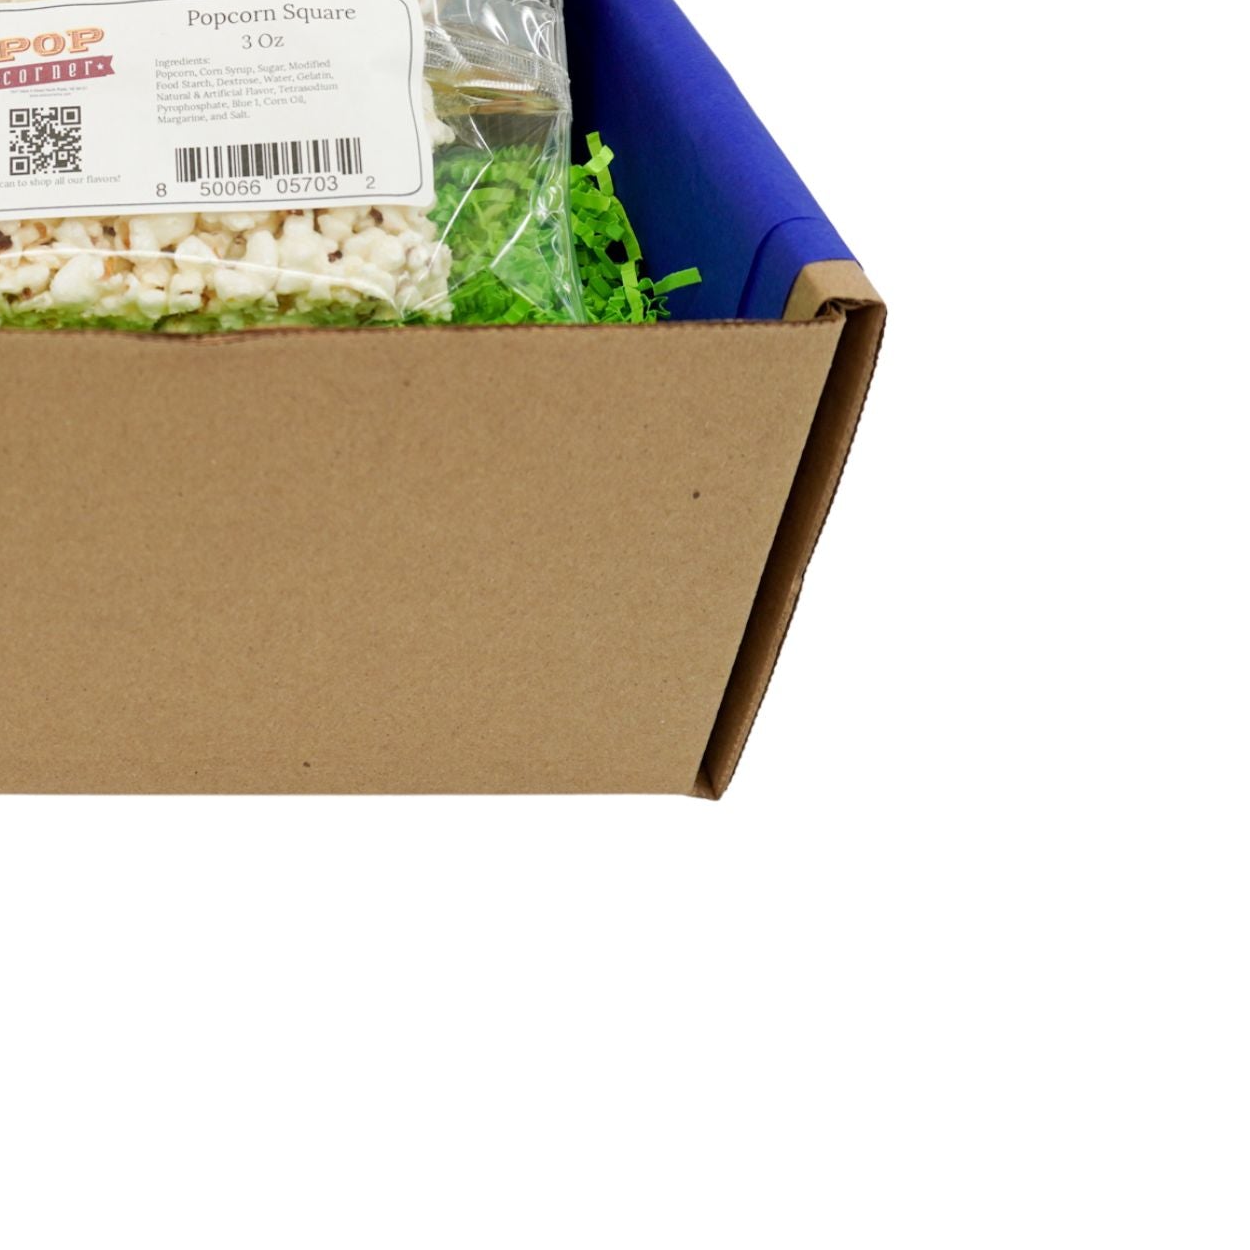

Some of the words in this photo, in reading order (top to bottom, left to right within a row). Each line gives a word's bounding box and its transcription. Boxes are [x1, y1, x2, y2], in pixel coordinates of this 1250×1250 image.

[188, 7, 276, 30] Popcorn
[283, 3, 356, 23] Square
[242, 34, 252, 49] 3
[258, 33, 285, 49] Oz
[155, 56, 210, 69] Ingredients:
[155, 69, 197, 80] Popcorn,
[199, 67, 222, 77] Corn
[225, 65, 255, 77] Syrup,
[257, 63, 287, 74] Sugar,
[289, 59, 331, 71] Modified
[3, 60, 93, 86] corner
[156, 80, 179, 90] Food
[181, 79, 214, 89] Starch,
[216, 76, 262, 87] Dextrose,
[264, 74, 295, 84] Water,
[296, 71, 334, 81] Gelatin,
[156, 91, 191, 102] Natural
[193, 90, 201, 100] &
[203, 87, 243, 99] Artificial
[245, 86, 276, 96] Flavor,
[278, 83, 338, 94] Tetrasodium
[157, 101, 230, 115] Pyrophosphate,
[232, 99, 253, 109] Blue
[263, 97, 288, 106] Corn
[157, 113, 209, 126] Margarine,
[210, 111, 228, 121] and
[229, 110, 251, 120] Salt.
[17, 179, 28, 187] to
[30, 177, 52, 188] shop
[54, 176, 66, 185] all
[67, 177, 84, 185] our
[86, 174, 121, 184] flavors!
[156, 183, 167, 197] 8
[199, 179, 262, 196] 50066
[276, 175, 339, 194] 05703
[365, 175, 376, 190] 2
